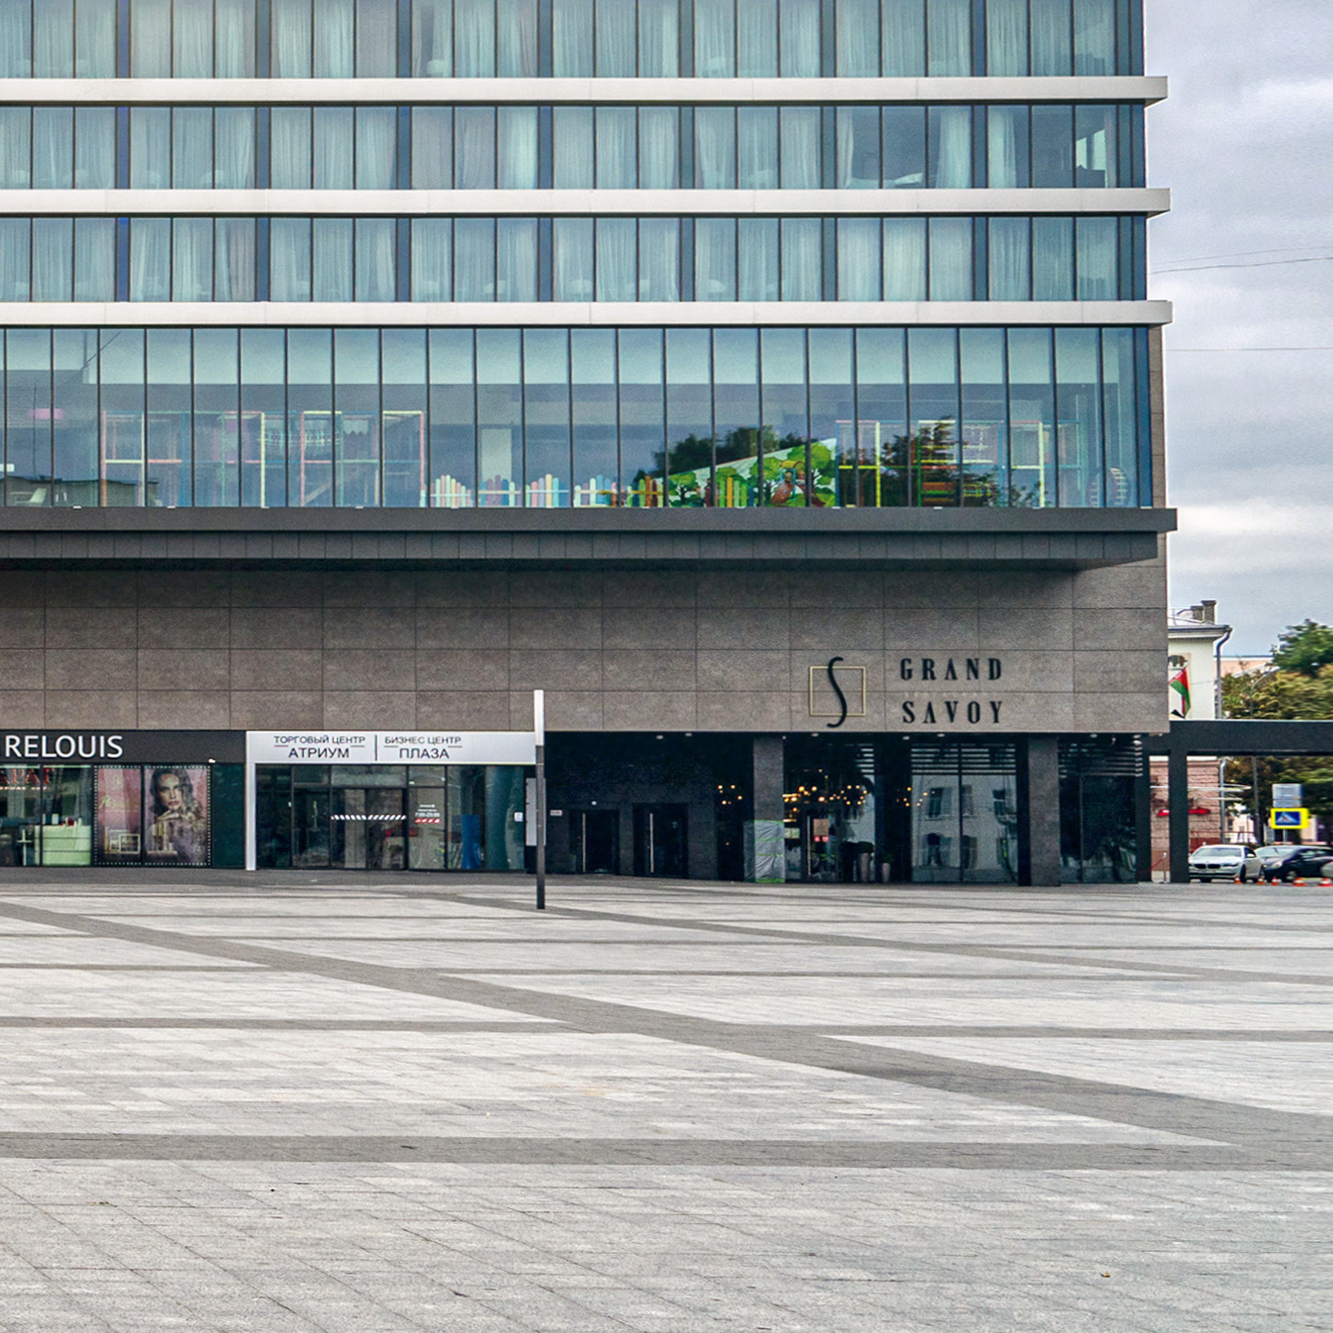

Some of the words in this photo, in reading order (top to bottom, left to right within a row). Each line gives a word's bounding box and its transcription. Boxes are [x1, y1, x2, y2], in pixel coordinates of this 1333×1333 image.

[899, 657, 1002, 681] GRAND
[901, 700, 1003, 724] SAVOY
[4, 734, 124, 758] RELOUIS
[273, 734, 330, 744] ТОРГОВЫЙ
[332, 735, 366, 746] ЦЕНТР
[384, 736, 426, 745] БИЗНЕС
[427, 736, 462, 746] ЦЕНТР
[288, 747, 350, 759] АТРИУМ
[399, 748, 450, 759] ПЛАЗА
